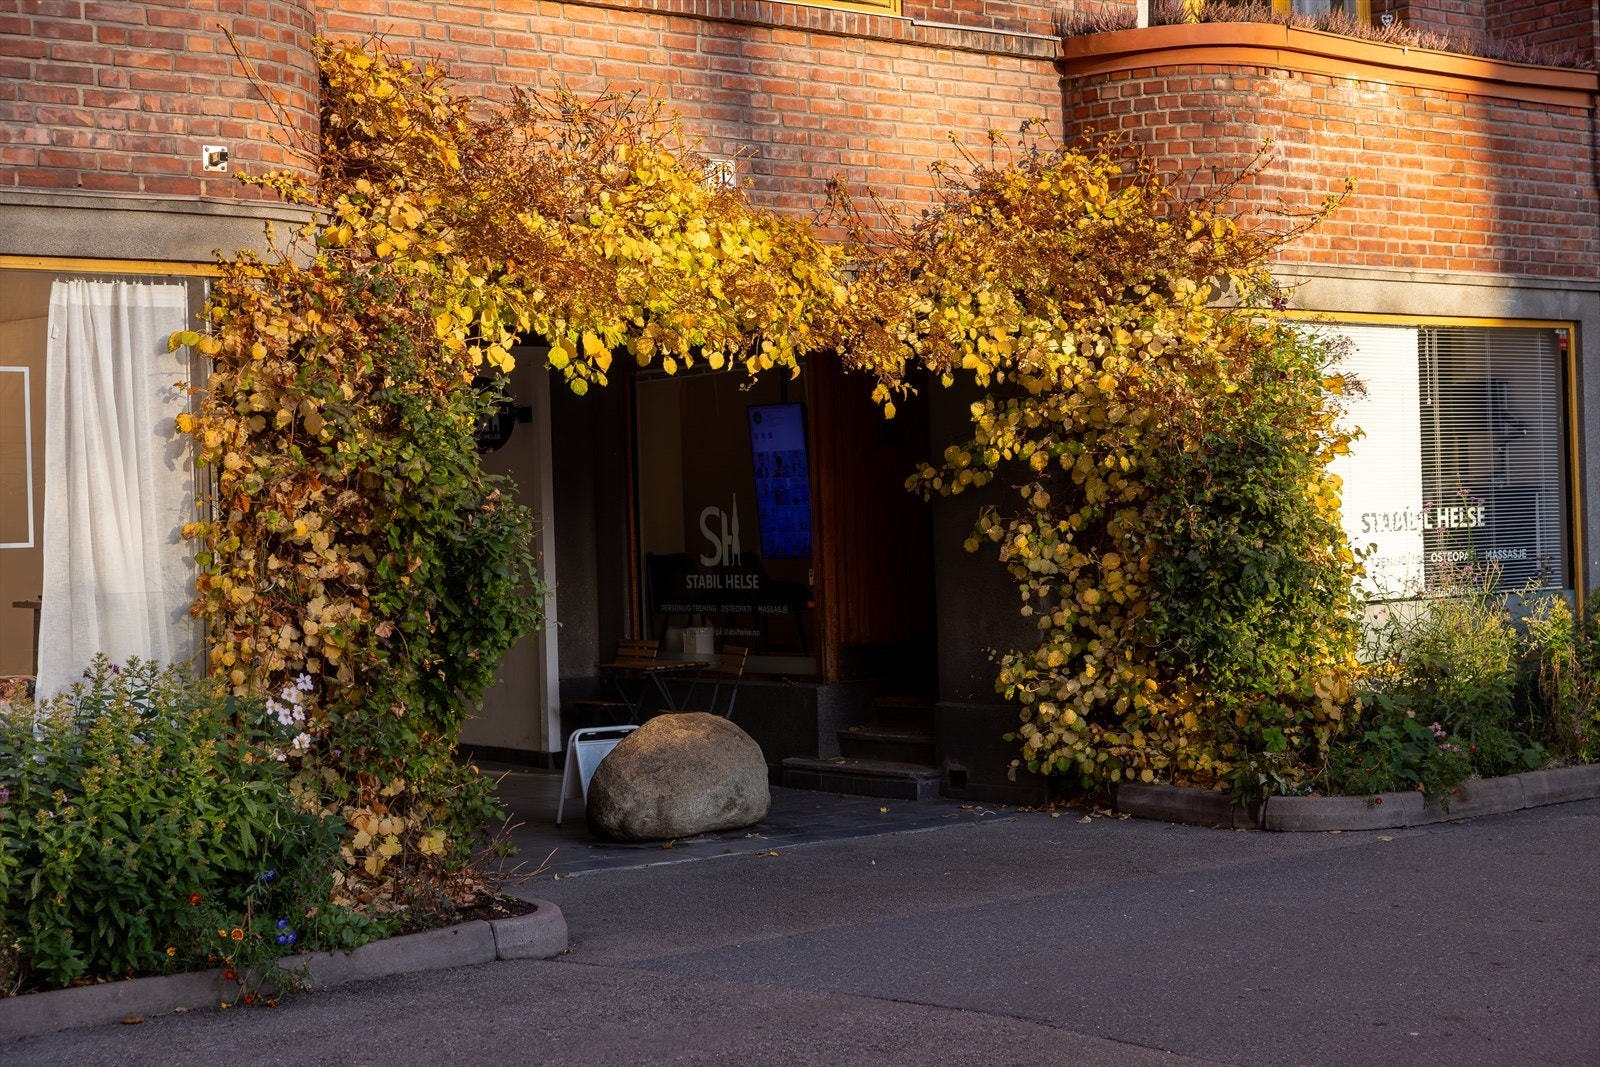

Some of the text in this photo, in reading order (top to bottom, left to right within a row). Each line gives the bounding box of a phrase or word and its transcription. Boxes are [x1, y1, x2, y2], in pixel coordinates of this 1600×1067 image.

[1437, 507, 1486, 528] HELSE
[1431, 549, 1527, 563] OSTEOPA MASSASJE
[686, 574, 760, 590] STABIL HELSE
[660, 604, 789, 613] PERSONLIG TRENING OSTEOPATI MASSASJE
